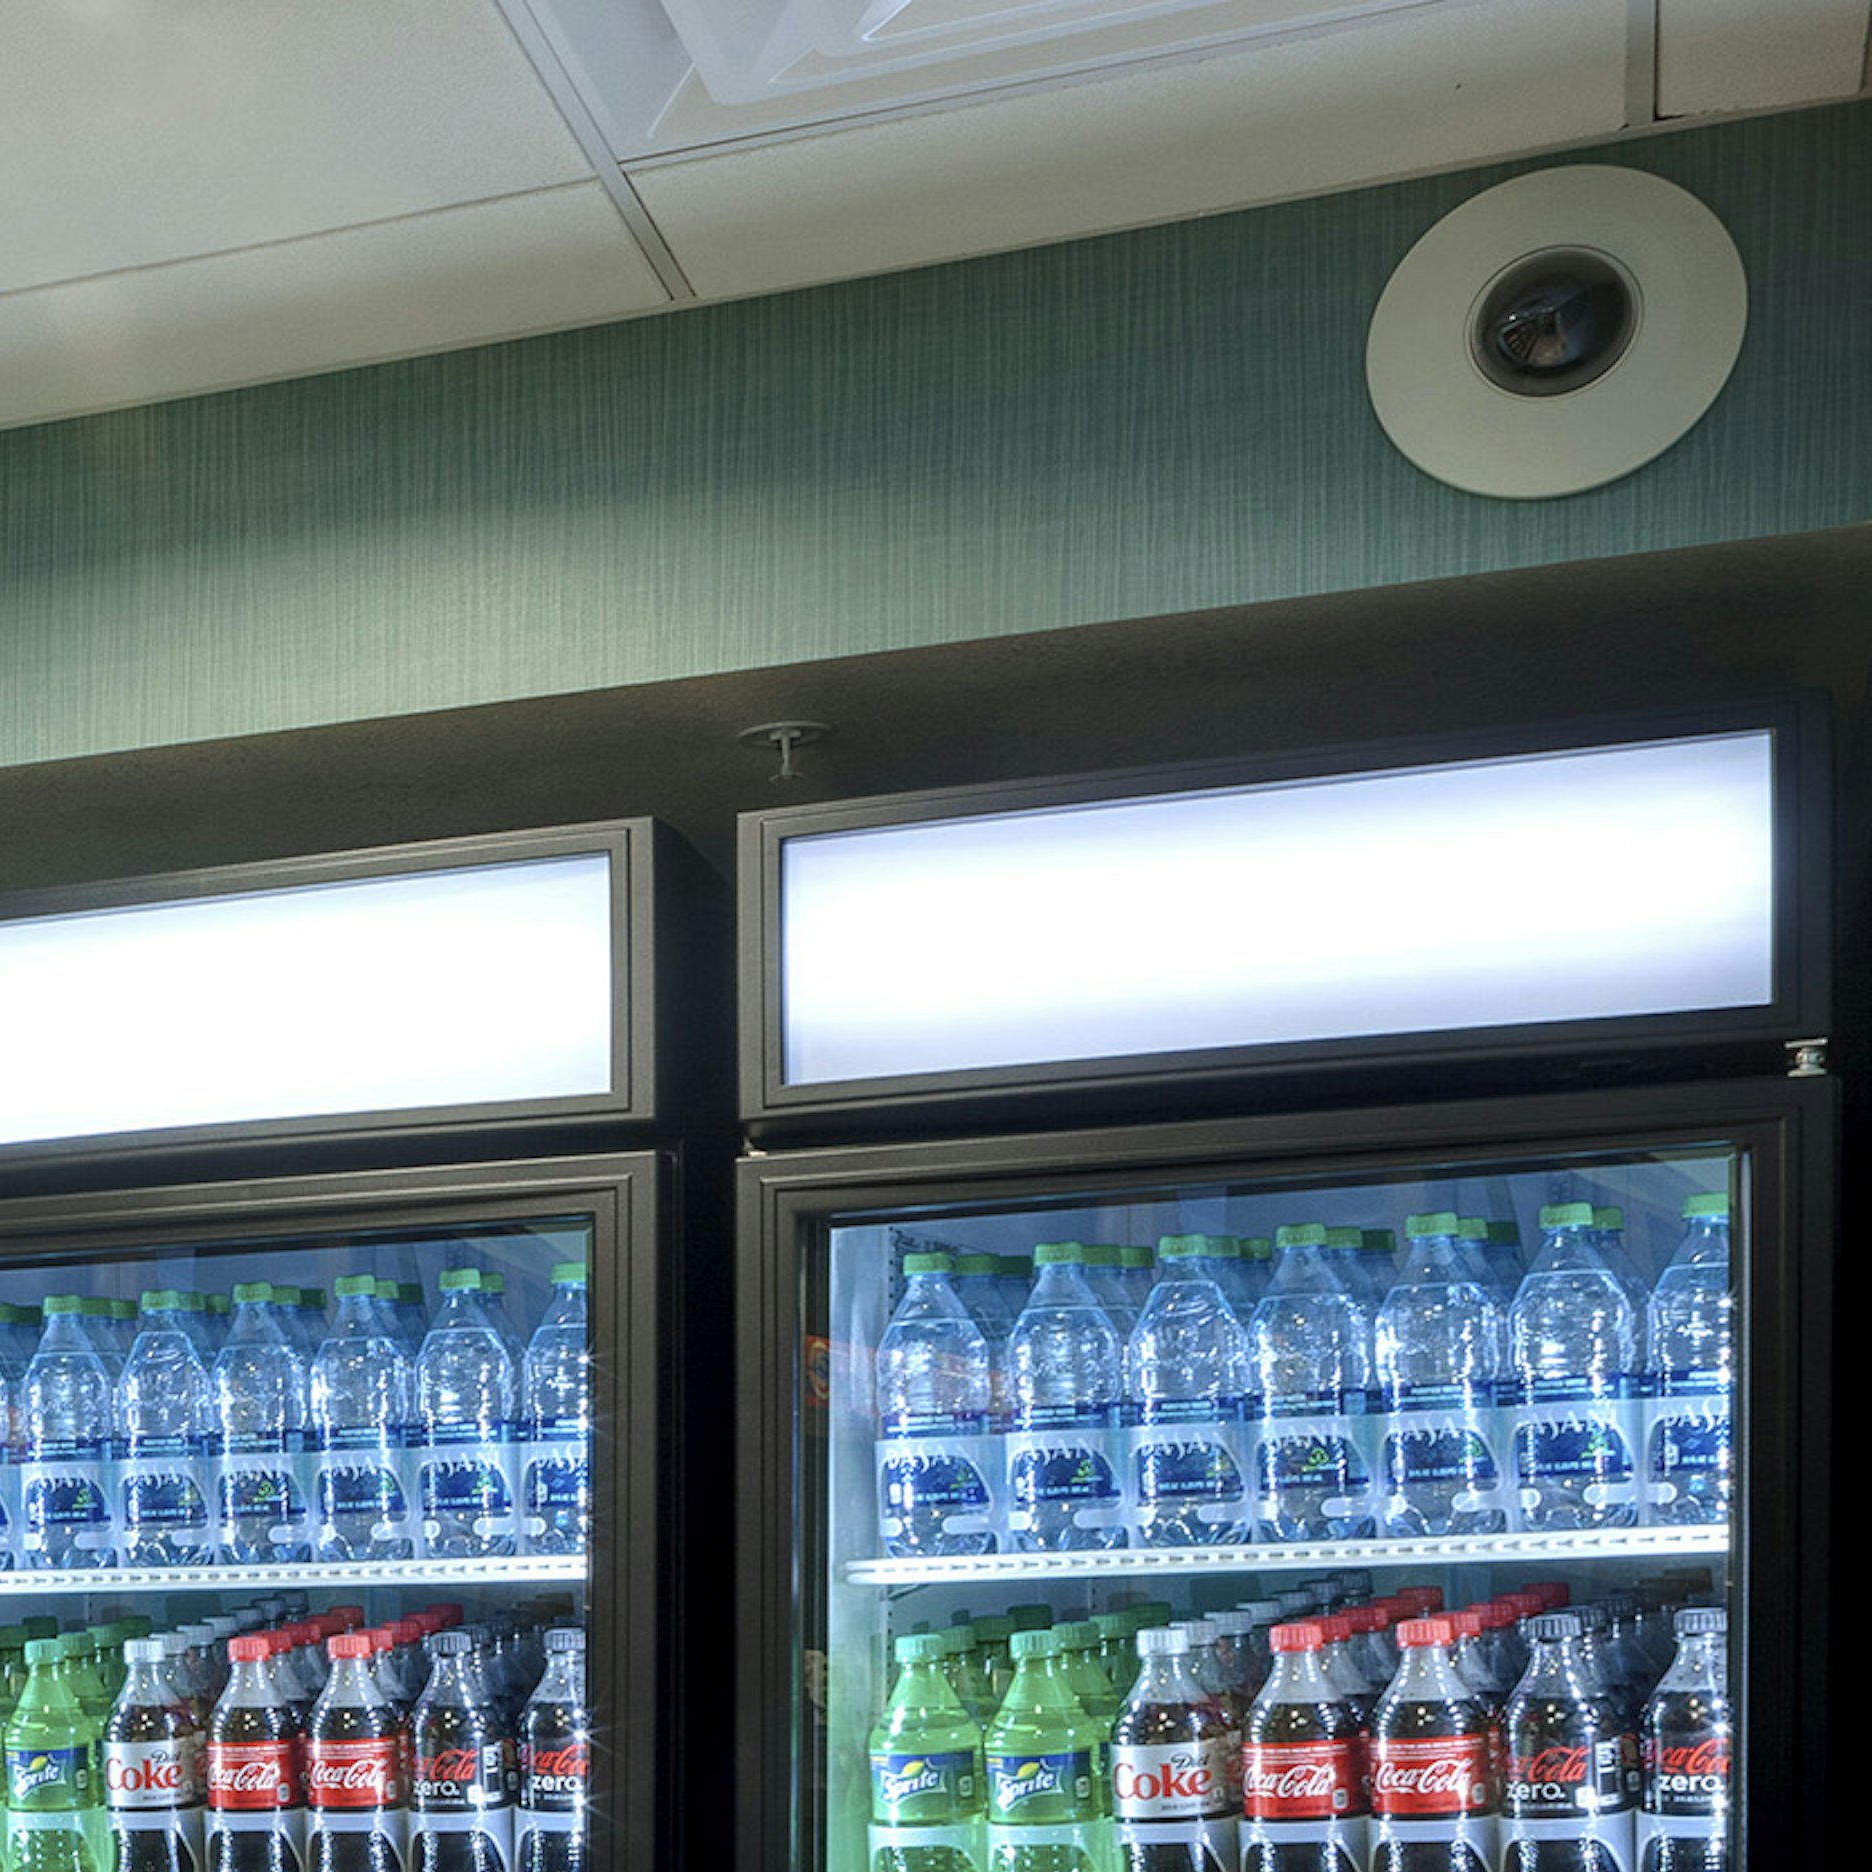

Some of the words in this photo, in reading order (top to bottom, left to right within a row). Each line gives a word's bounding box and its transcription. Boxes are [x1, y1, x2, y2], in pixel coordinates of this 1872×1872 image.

[106, 1757, 182, 1791] Coke
[208, 1760, 280, 1790] Coca-Cola
[310, 1759, 387, 1790] Coca-Cola
[883, 1768, 941, 1800] Sprite
[998, 1768, 1055, 1803] Sprite
[1113, 1762, 1211, 1800] Coke
[1243, 1762, 1334, 1799] Coca-Cola
[1375, 1760, 1474, 1798] Coca-Cola
